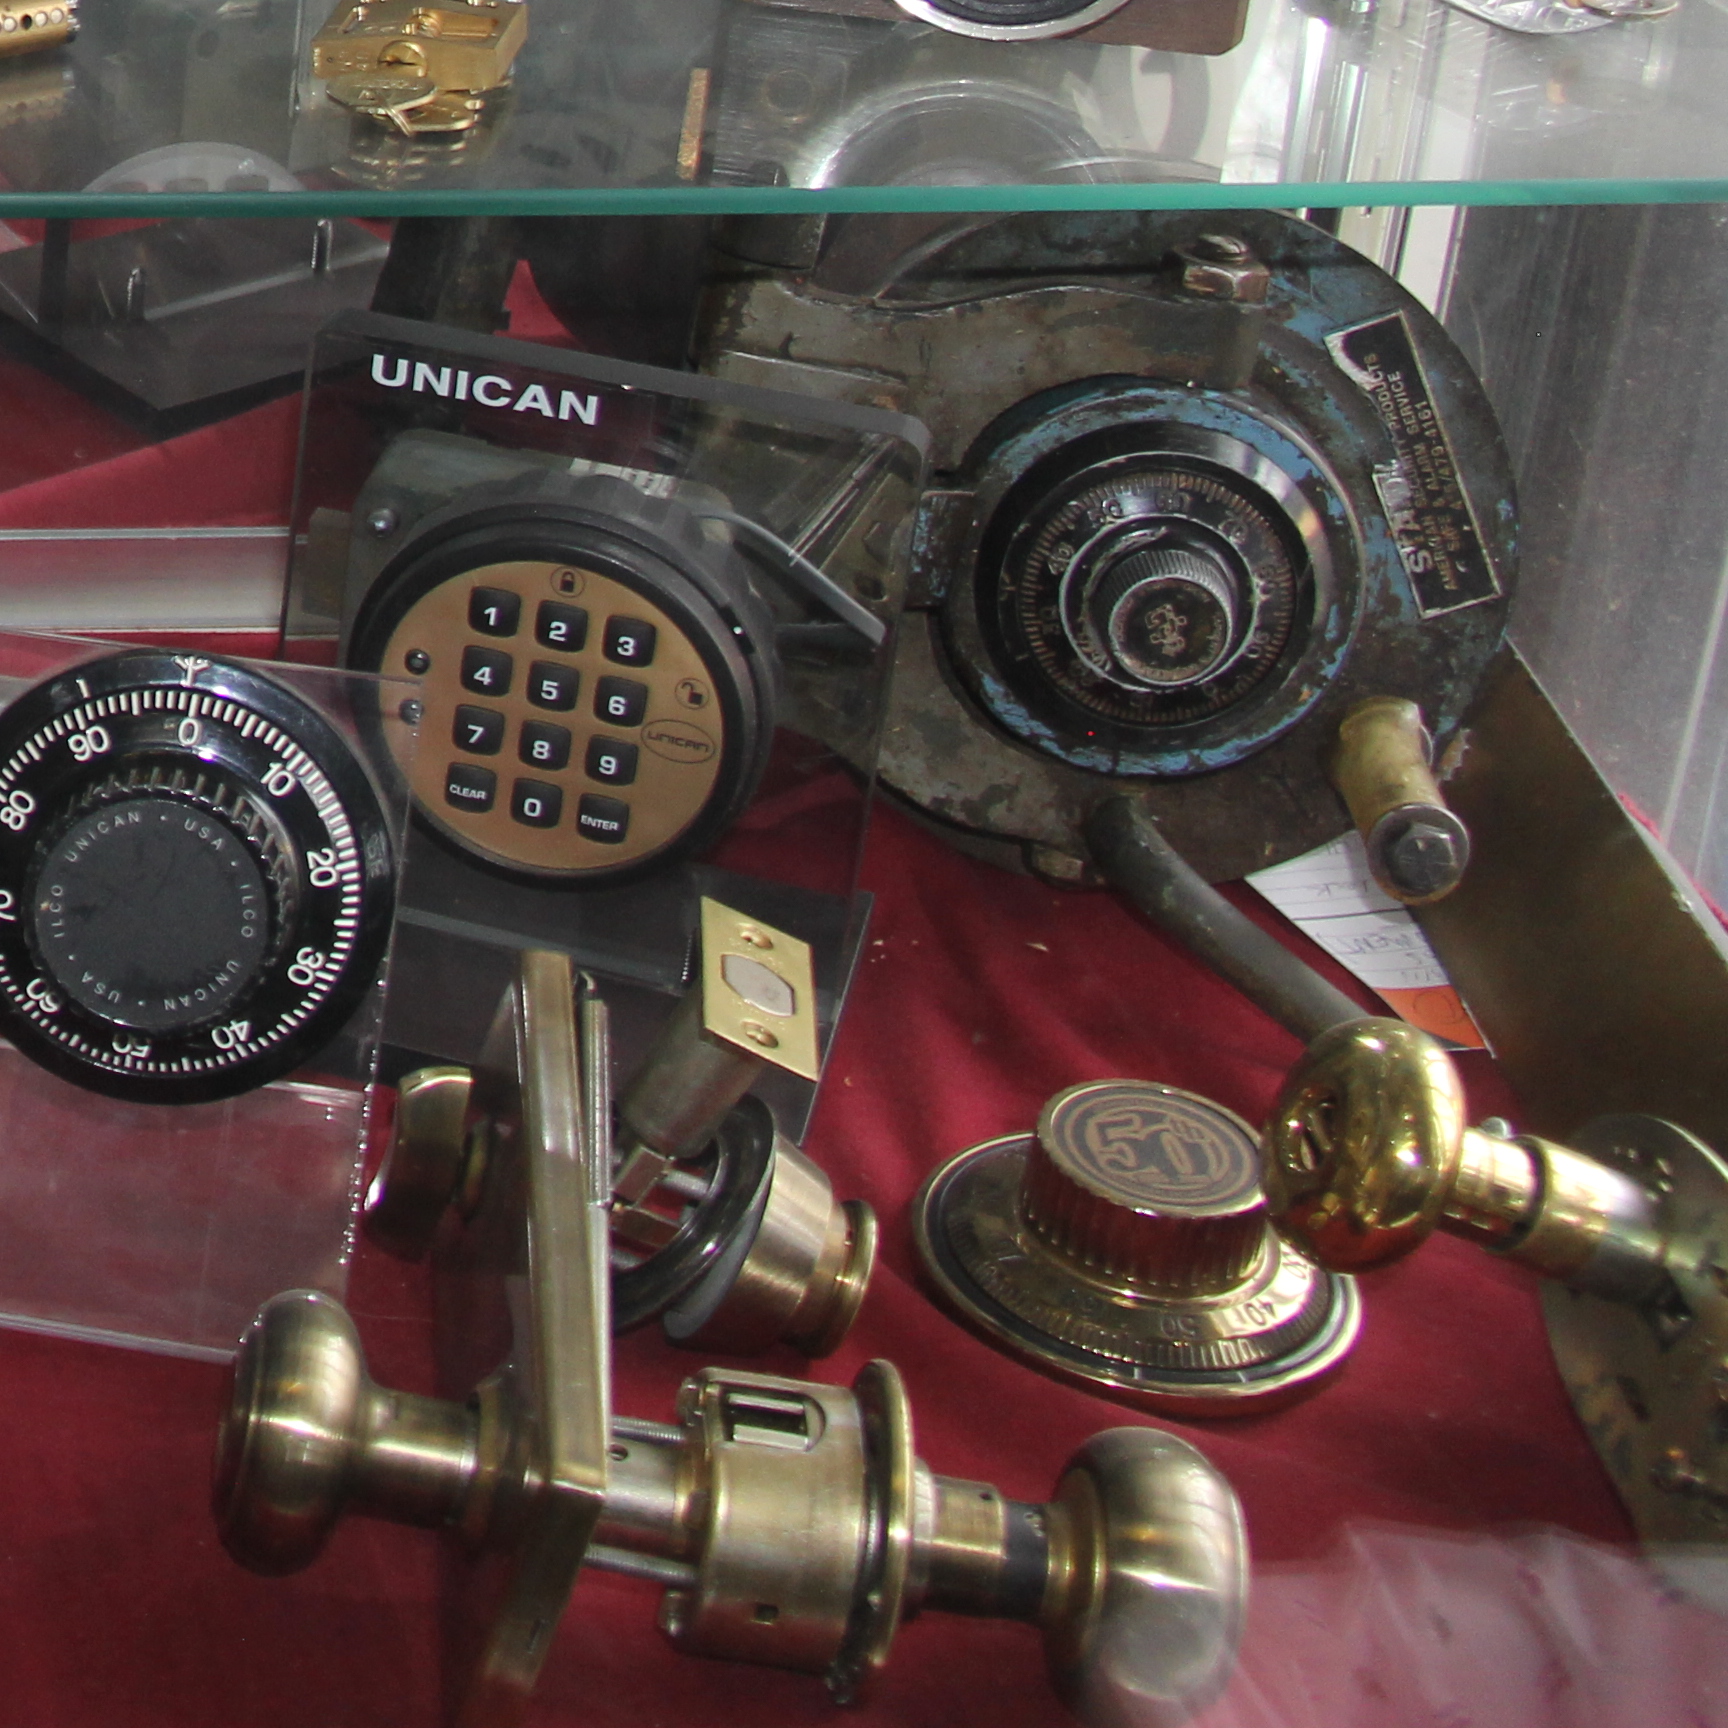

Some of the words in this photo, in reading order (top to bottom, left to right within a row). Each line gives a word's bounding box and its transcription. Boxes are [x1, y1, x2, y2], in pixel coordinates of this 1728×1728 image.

[370, 354, 601, 426] UNICAN
[1387, 370, 1421, 436] SERVICE
[484, 605, 498, 627] 1
[548, 621, 567, 643] 2
[617, 636, 636, 656] 3
[473, 665, 492, 686] 4
[540, 680, 559, 700] 5
[607, 696, 626, 716] 6
[67, 724, 111, 761] 90
[177, 720, 202, 746] 0
[466, 724, 485, 745] 7
[532, 740, 551, 760] 8
[598, 755, 617, 775] 9
[647, 732, 710, 754] UNICAN
[260, 761, 295, 798] 10
[0, 789, 36, 832] 80
[448, 783, 487, 801] CLEAR
[523, 797, 542, 818] 0
[580, 814, 619, 832] ENTER
[66, 811, 140, 864] UNICAN
[184, 817, 224, 852] USA
[239, 883, 254, 938] ILCO
[306, 847, 339, 888] 20
[287, 946, 324, 987] 30
[25, 977, 61, 1013] 60
[111, 1031, 152, 1059] 50
[211, 1019, 254, 1050] 40
